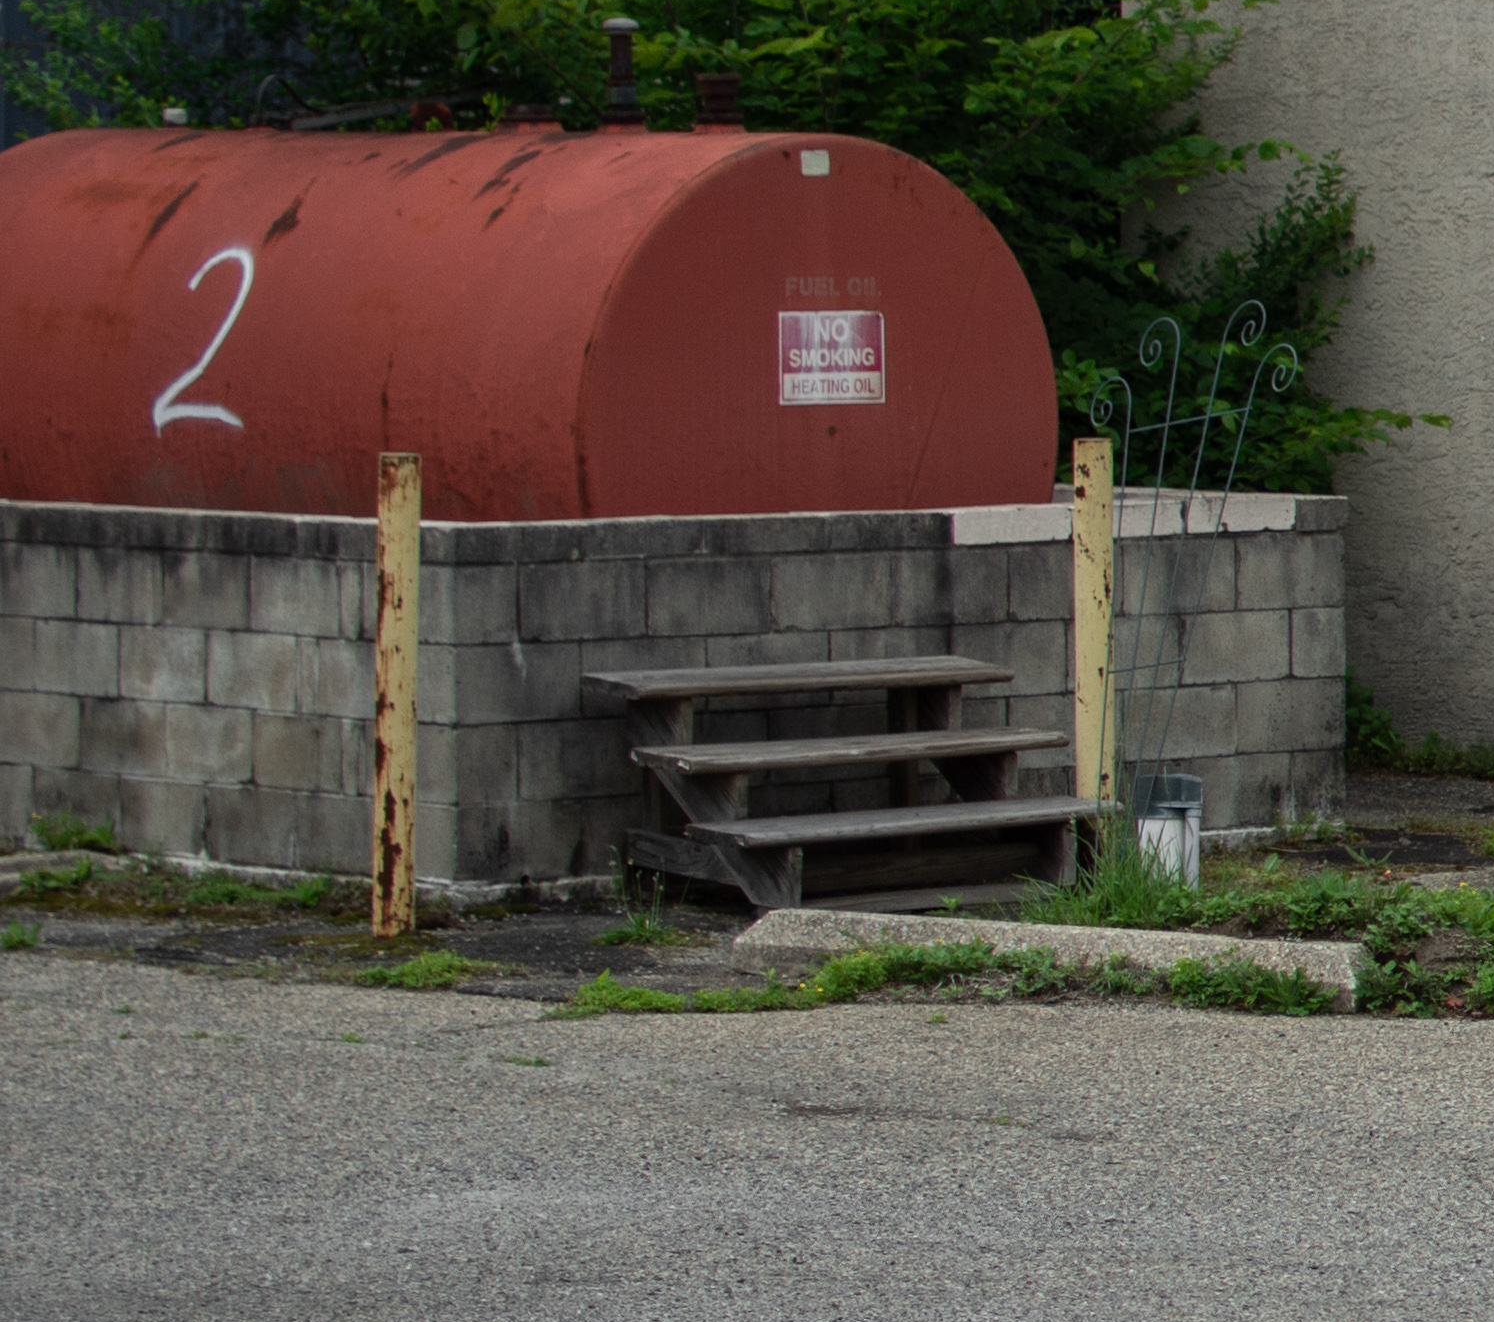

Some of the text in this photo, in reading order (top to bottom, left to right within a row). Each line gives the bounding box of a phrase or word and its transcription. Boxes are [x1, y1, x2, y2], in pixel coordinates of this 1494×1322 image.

[786, 276, 882, 297] FUEL OIL
[814, 318, 850, 343] NO
[152, 246, 254, 438] 2
[789, 347, 876, 368] SMOKING
[792, 378, 875, 395] HEATING OIL
